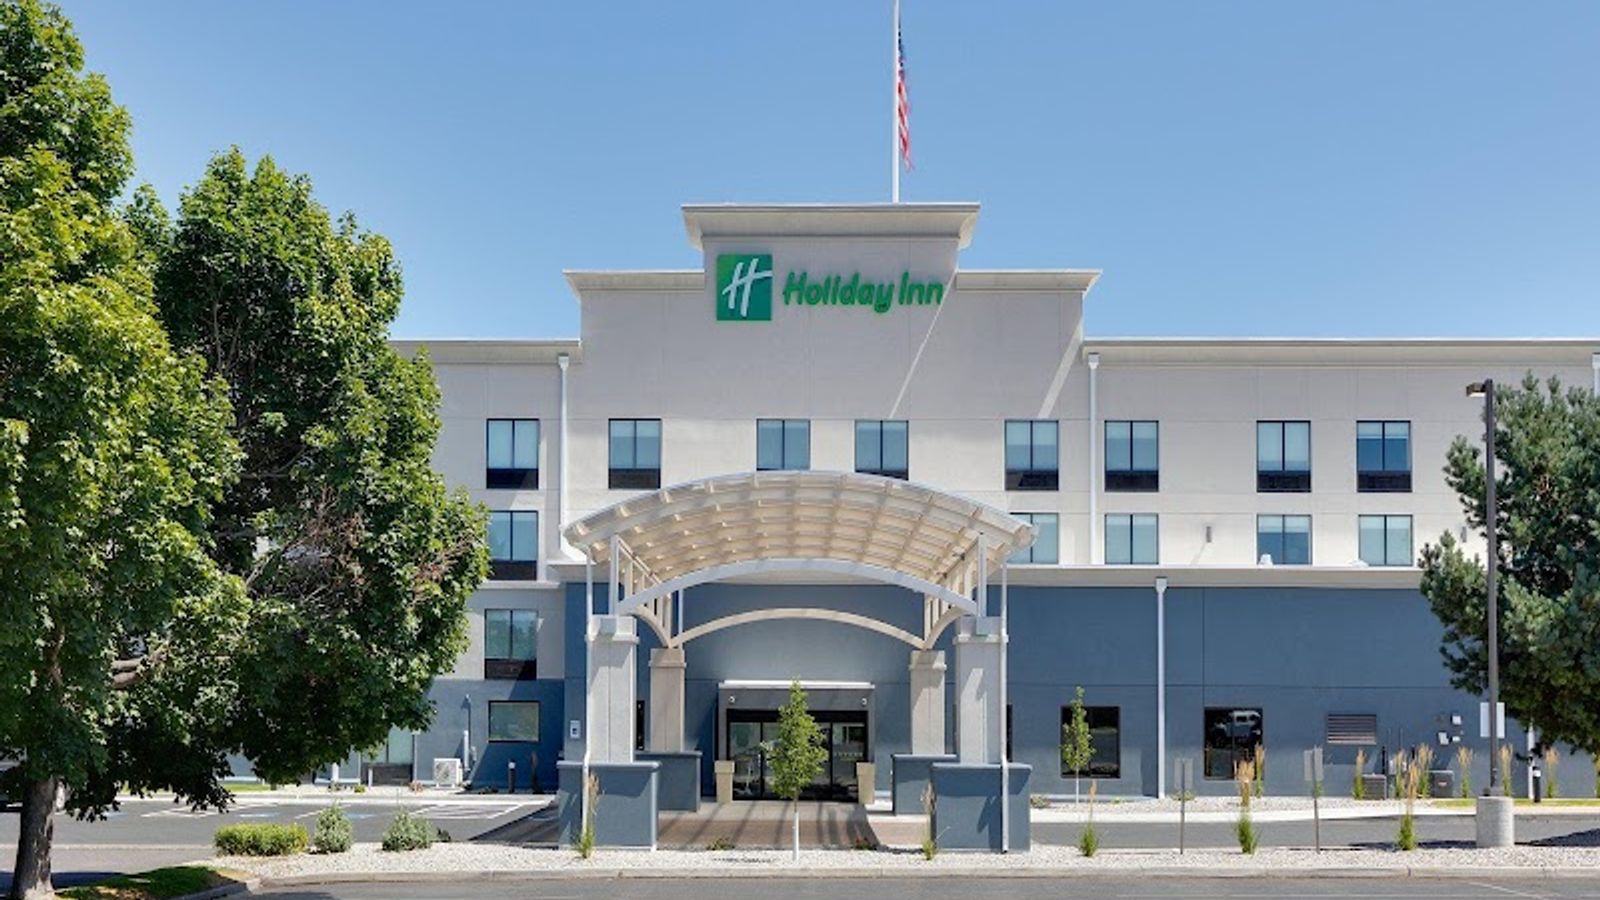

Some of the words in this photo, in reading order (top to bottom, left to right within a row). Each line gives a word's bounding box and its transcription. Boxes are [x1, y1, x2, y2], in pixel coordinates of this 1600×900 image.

[722, 258, 773, 317] H
[783, 271, 895, 313] Holiday
[898, 271, 944, 305] Inn
